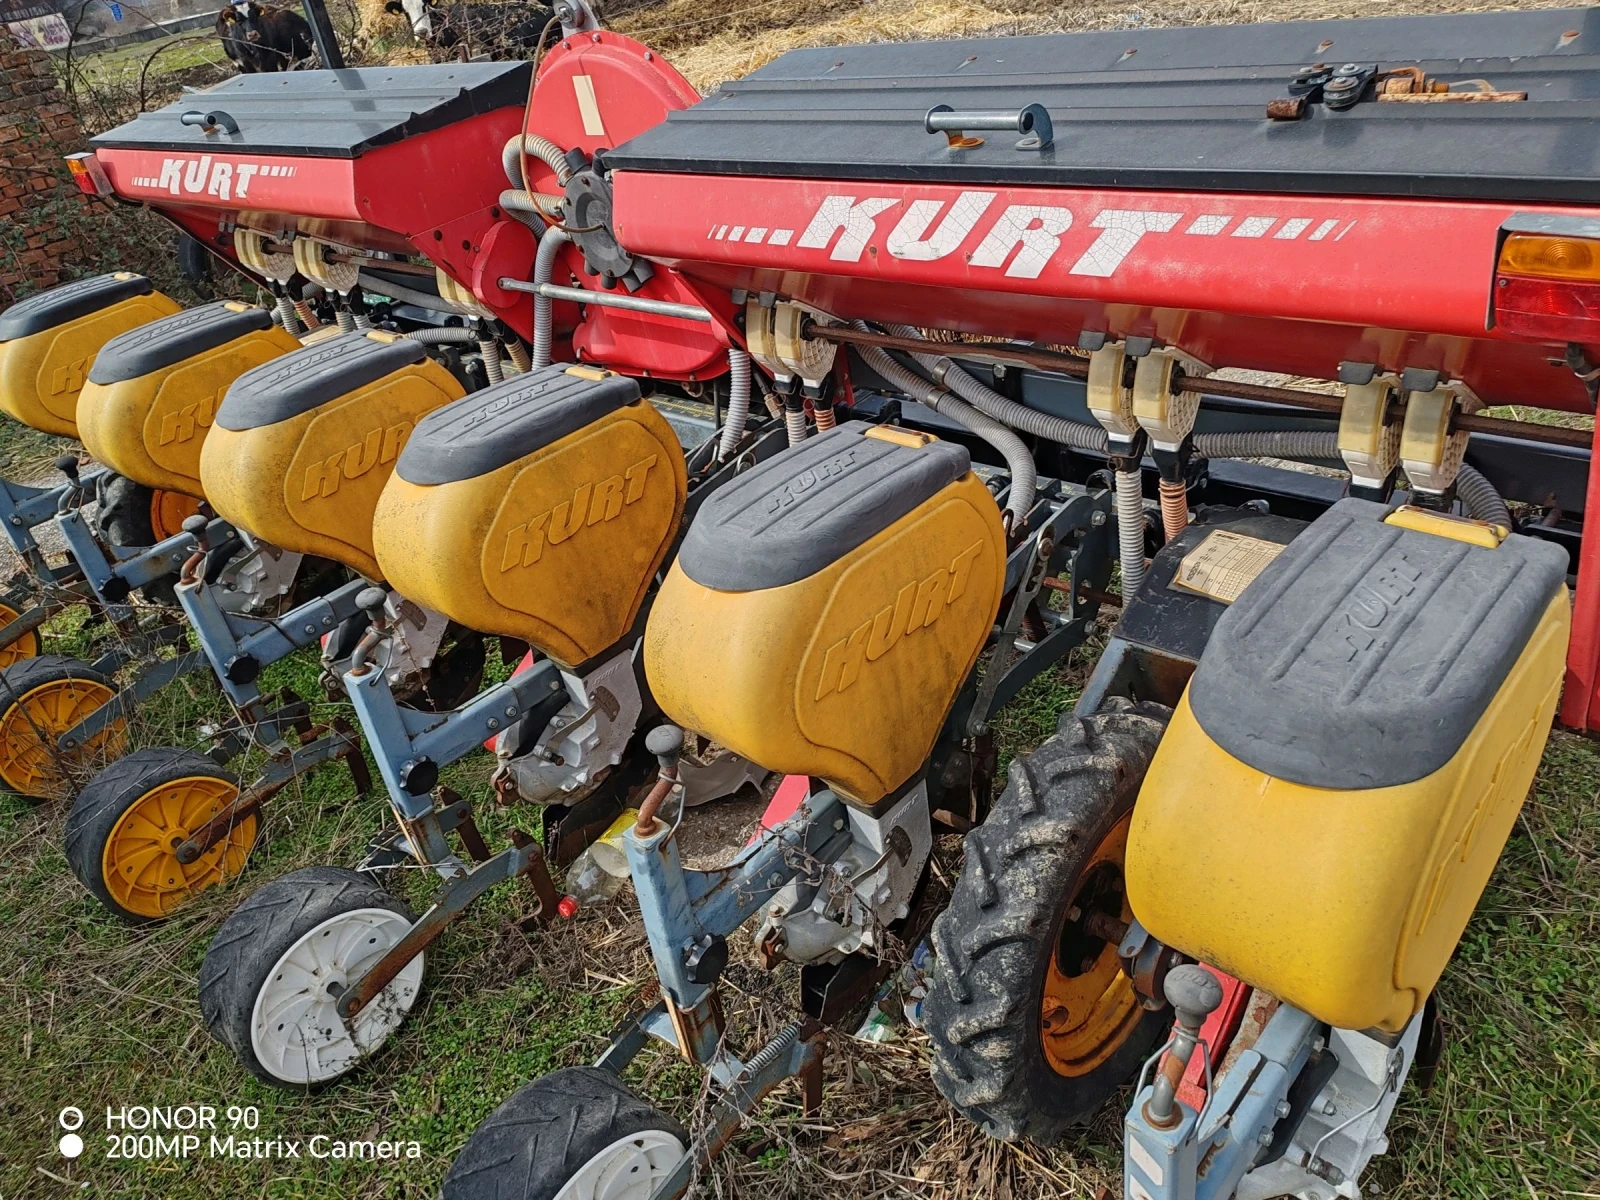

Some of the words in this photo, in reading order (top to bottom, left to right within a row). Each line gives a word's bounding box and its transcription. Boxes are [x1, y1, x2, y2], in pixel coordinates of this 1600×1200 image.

[159, 155, 258, 200] KURT
[796, 191, 1184, 279] KURT
[501, 453, 658, 573] KURT
[766, 450, 856, 515] KURT
[816, 538, 984, 702] KURT
[1317, 552, 1423, 663] KURT
